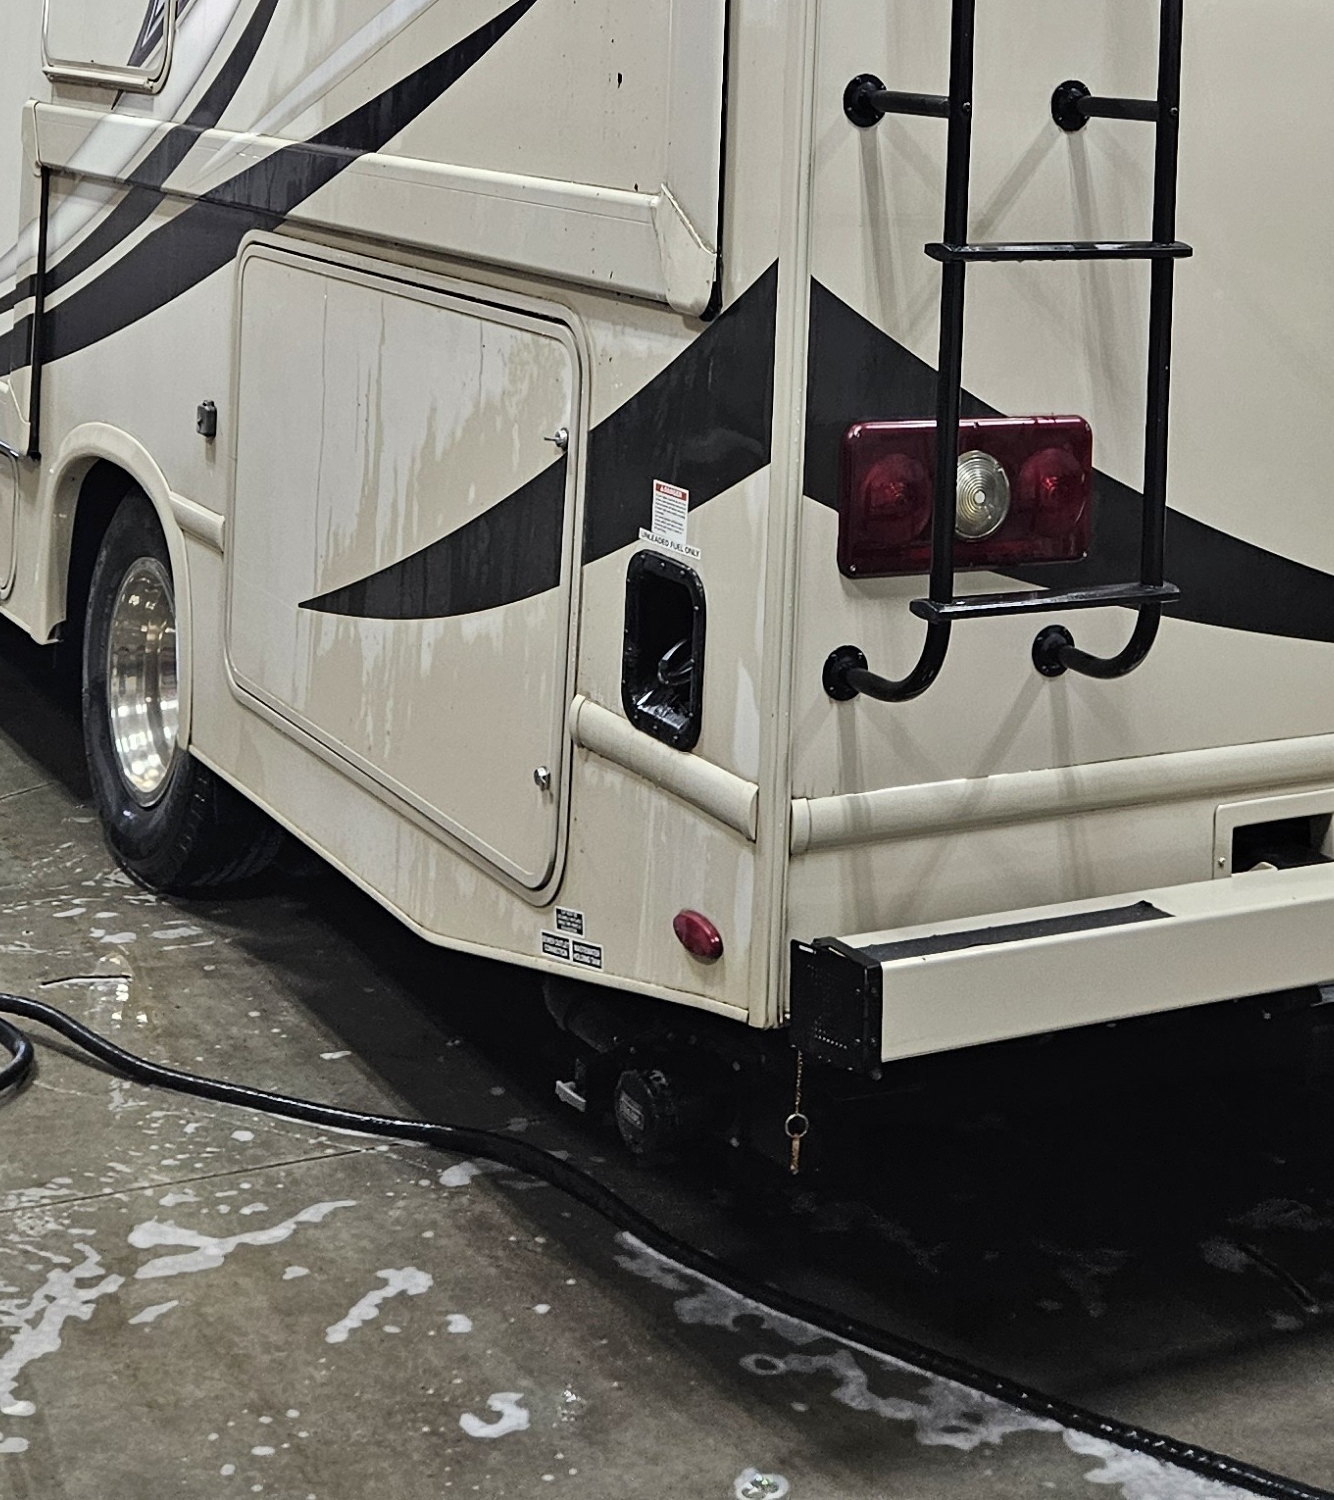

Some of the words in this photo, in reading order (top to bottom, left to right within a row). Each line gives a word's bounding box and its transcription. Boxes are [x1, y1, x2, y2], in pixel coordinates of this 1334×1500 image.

[641, 530, 670, 547] UNLEADED
[669, 540, 684, 553] FUEL
[684, 546, 700, 557] ONLY
